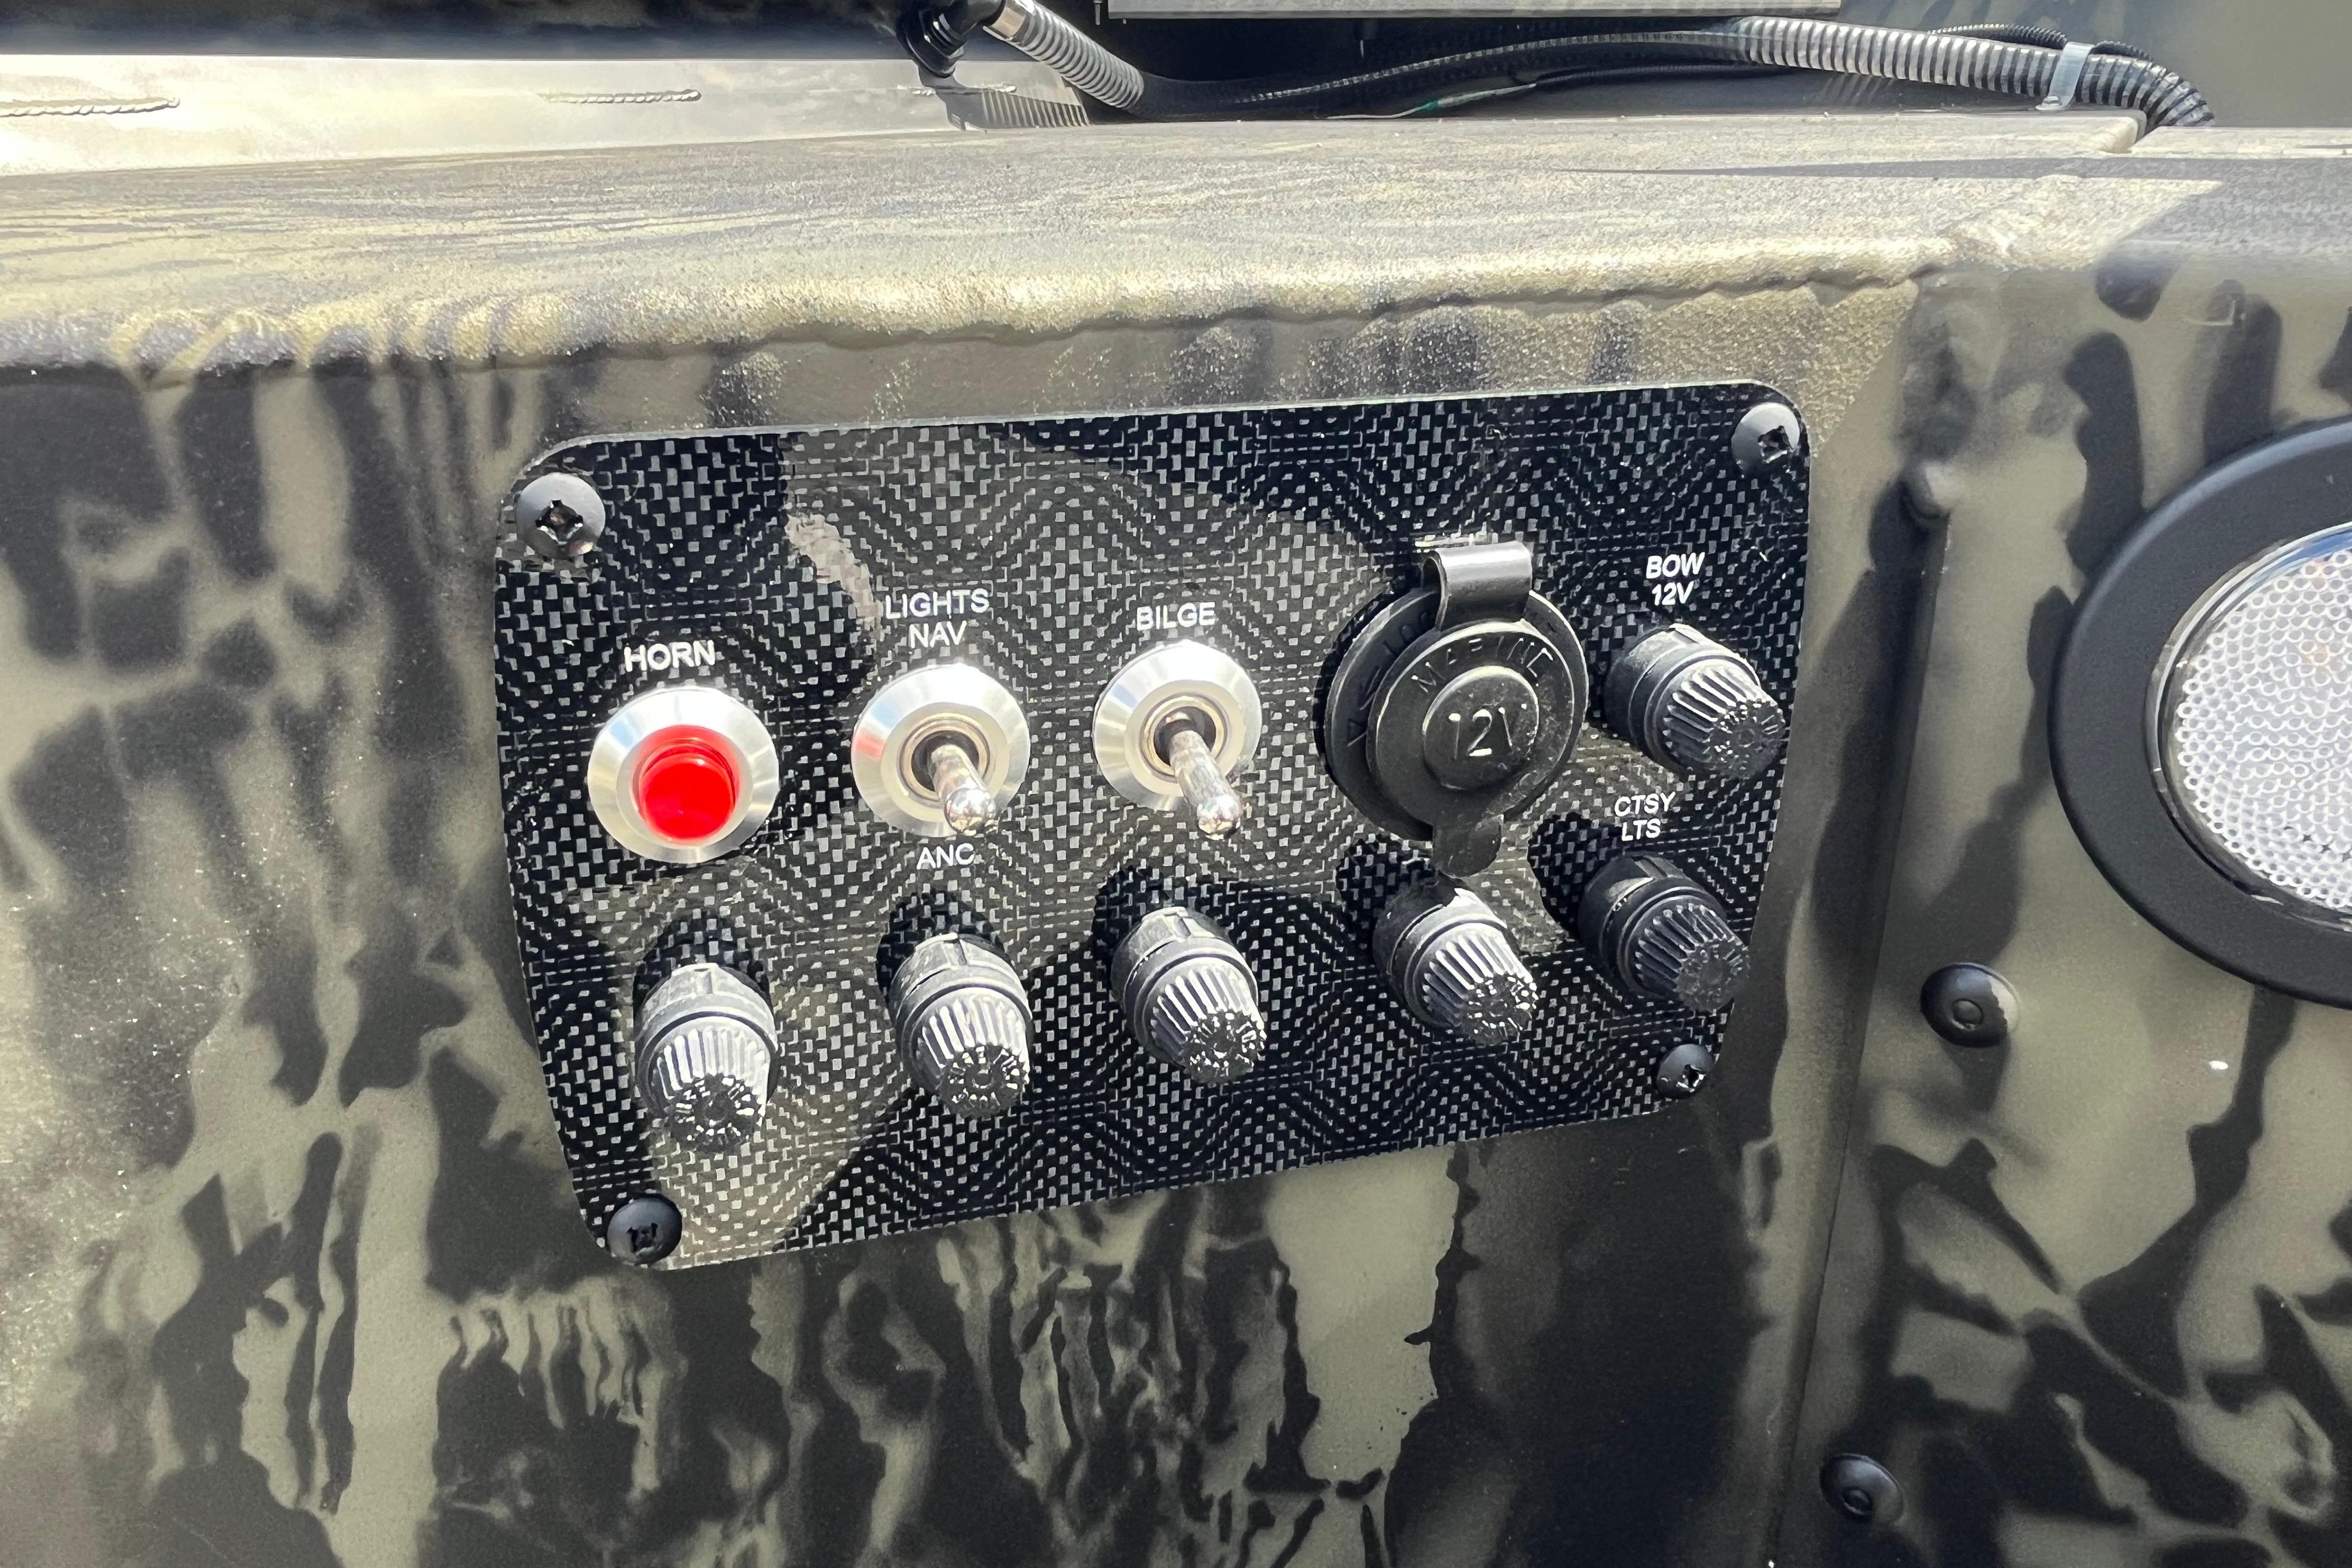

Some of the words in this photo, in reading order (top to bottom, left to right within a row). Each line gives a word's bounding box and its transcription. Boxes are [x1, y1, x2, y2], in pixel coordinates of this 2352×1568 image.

[1646, 551, 1704, 579] BOW
[885, 588, 990, 620] LIGHTS
[1651, 581, 1693, 606] 12V
[1136, 601, 1216, 631] BILGE
[908, 621, 967, 649] NAV
[624, 640, 715, 672] HORN
[1614, 791, 1676, 818] CTSY
[1621, 818, 1661, 842] LTS
[916, 843, 975, 870] ANC
